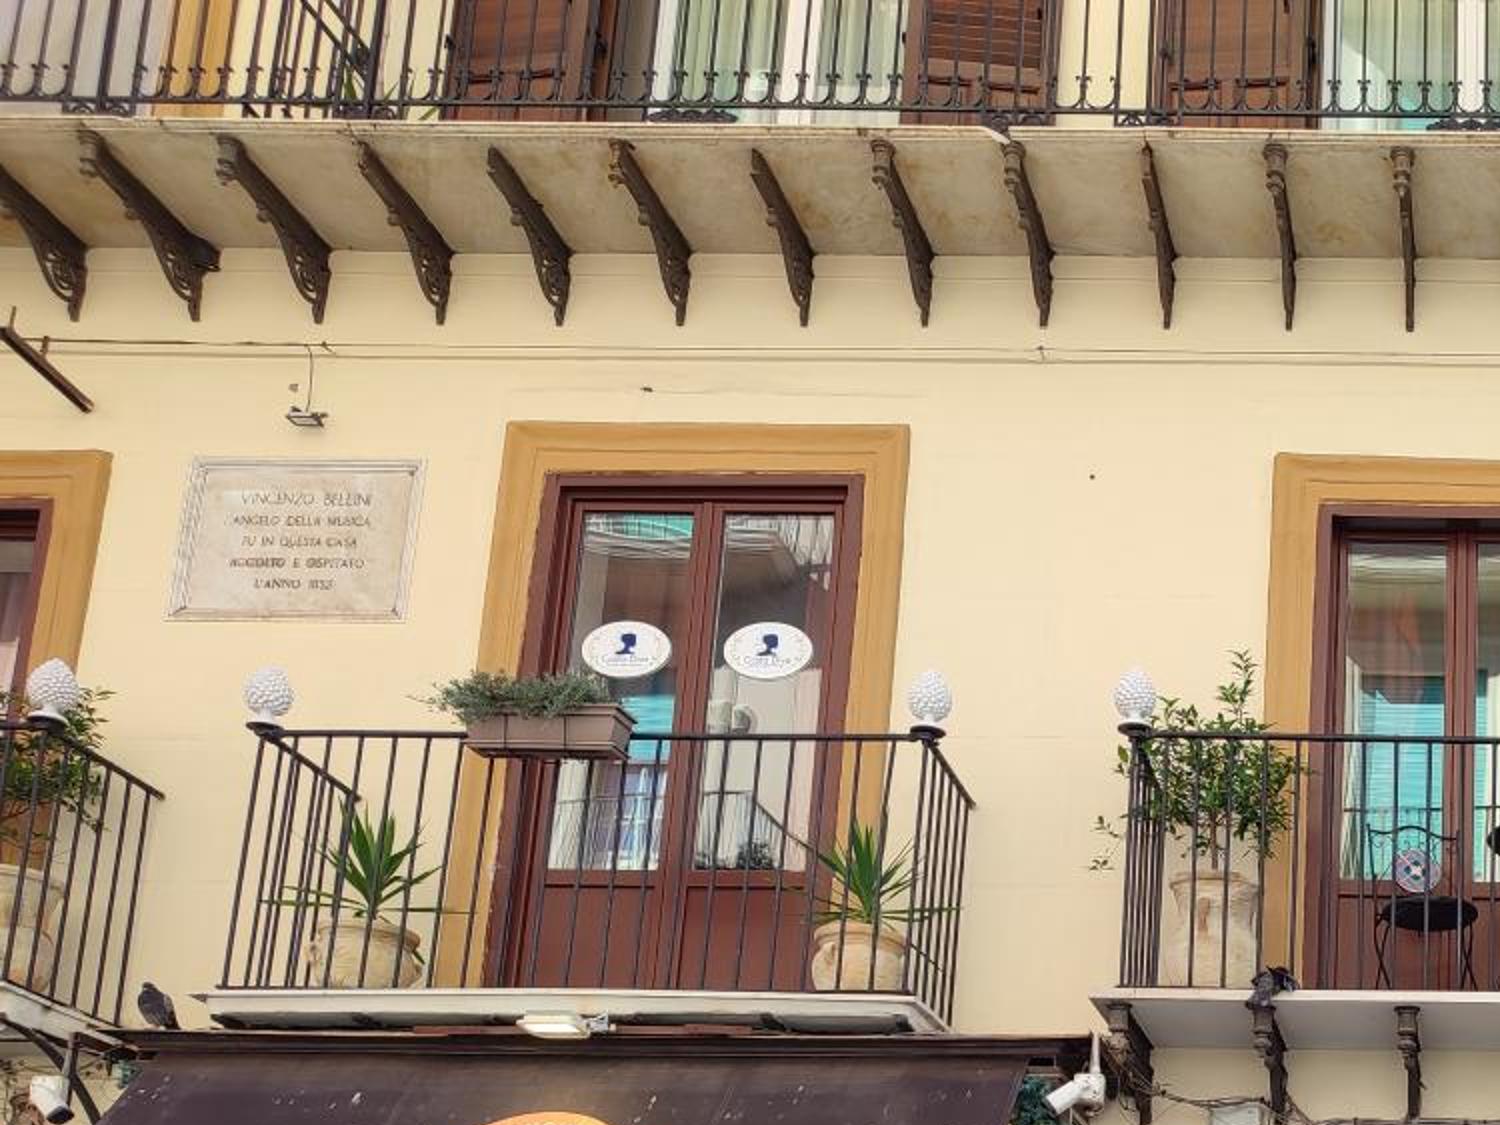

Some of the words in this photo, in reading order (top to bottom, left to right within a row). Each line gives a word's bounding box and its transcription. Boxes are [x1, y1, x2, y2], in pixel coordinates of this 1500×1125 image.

[323, 493, 372, 506] BELLINI
[233, 516, 280, 526] ANGELO
[286, 515, 321, 526] DELLA
[261, 536, 275, 546] IN
[280, 536, 321, 548] QUESTA
[326, 537, 357, 548] CASA
[305, 558, 365, 569] OSPITATO
